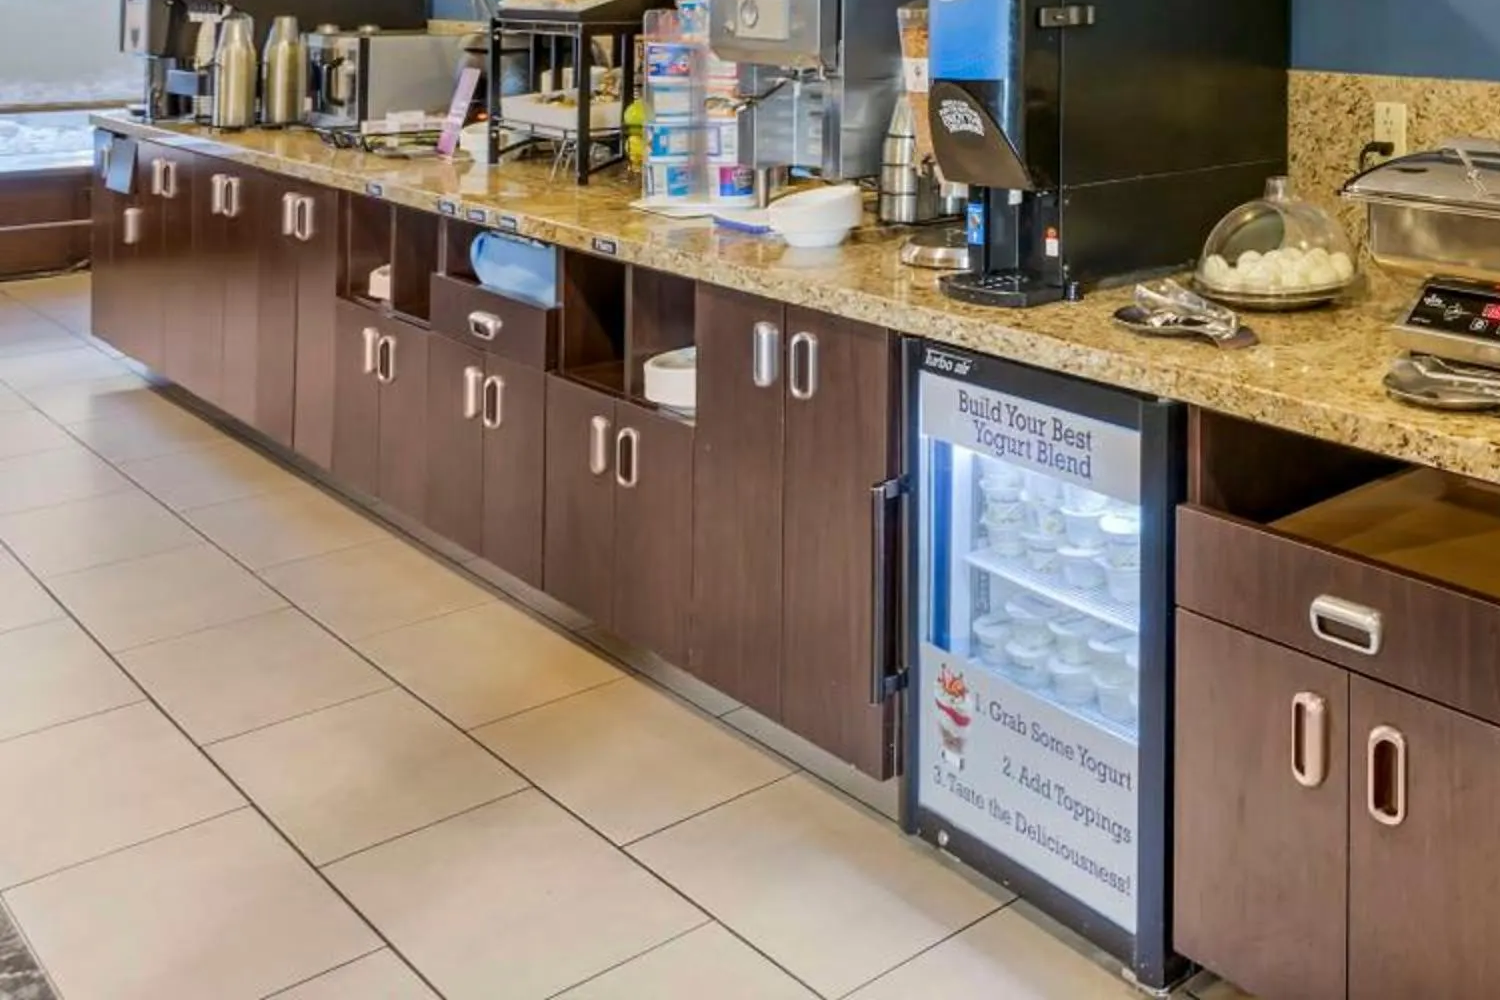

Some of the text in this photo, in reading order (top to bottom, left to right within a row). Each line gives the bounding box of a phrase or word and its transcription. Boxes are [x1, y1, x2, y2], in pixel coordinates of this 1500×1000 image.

[957, 388, 1093, 451] Build Your Best
[973, 419, 1092, 480] Yogurt Blend
[974, 692, 1133, 793] 1. Grab Some Yogurt
[933, 763, 1132, 898] 3. Taste the Deliciousness!
[1002, 755, 1133, 845] 2. Add Toppings
